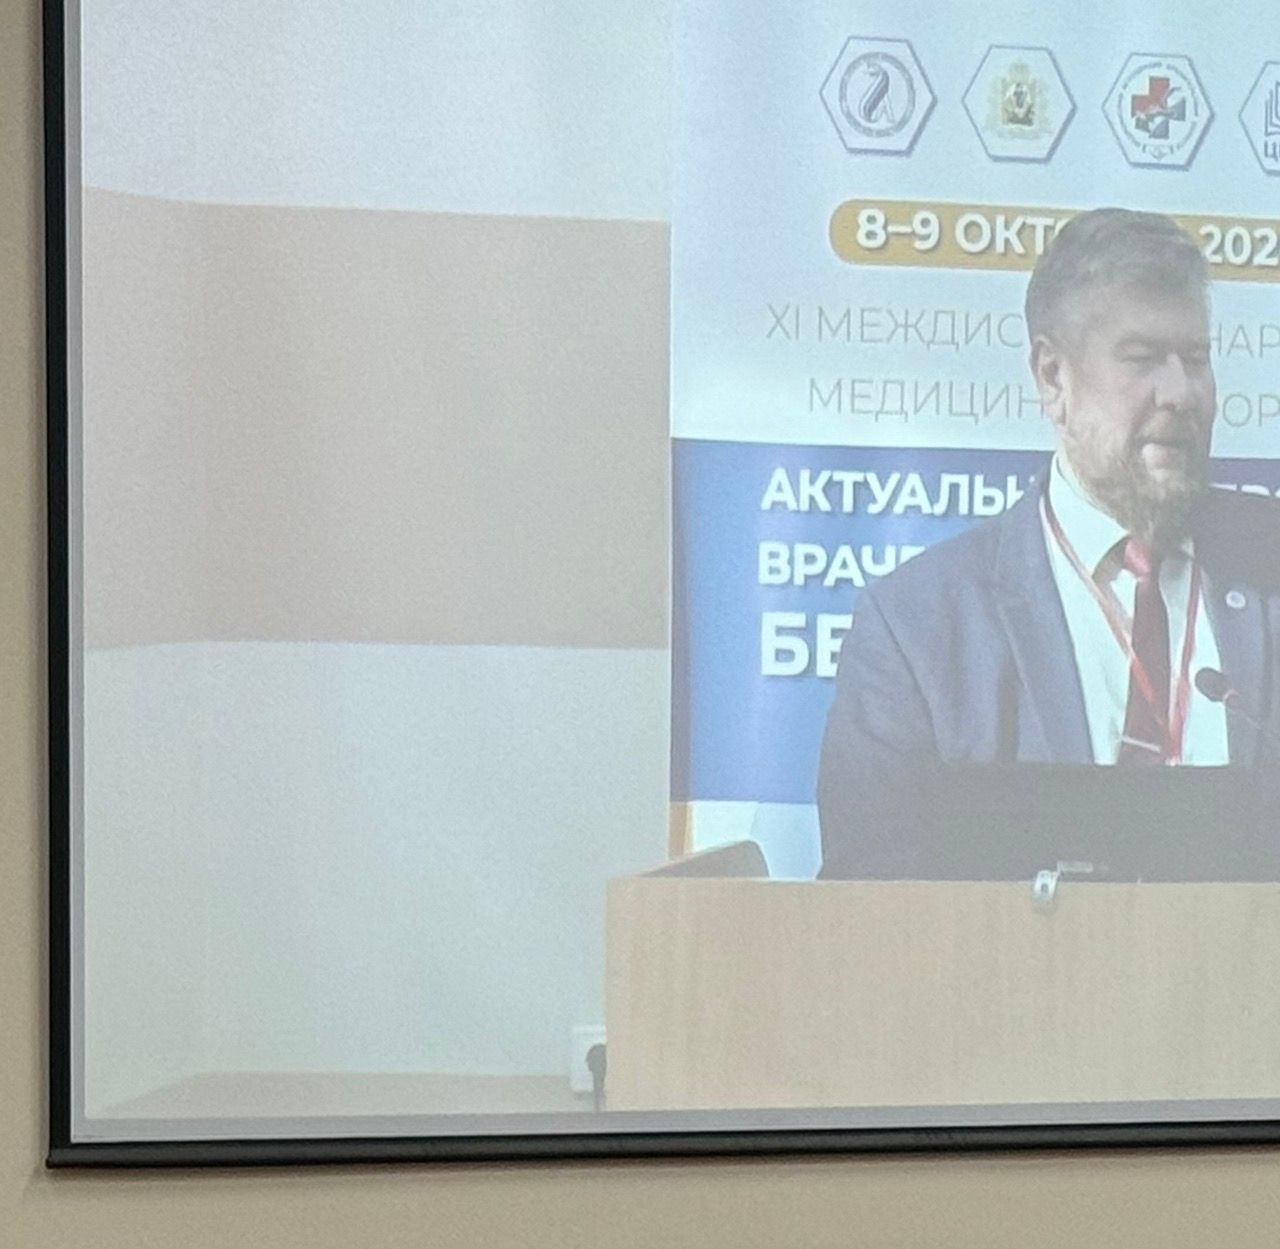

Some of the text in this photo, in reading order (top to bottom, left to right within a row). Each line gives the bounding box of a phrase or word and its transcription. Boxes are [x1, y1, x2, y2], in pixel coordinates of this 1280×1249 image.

[955, 212, 1070, 256] ОКТ
[766, 303, 800, 341] XI
[817, 305, 1025, 351] МЕЖДИС
[809, 377, 1045, 424] МЕДИЦИН
[757, 540, 926, 588] ВРАЧ
[760, 611, 854, 678] БЕ
